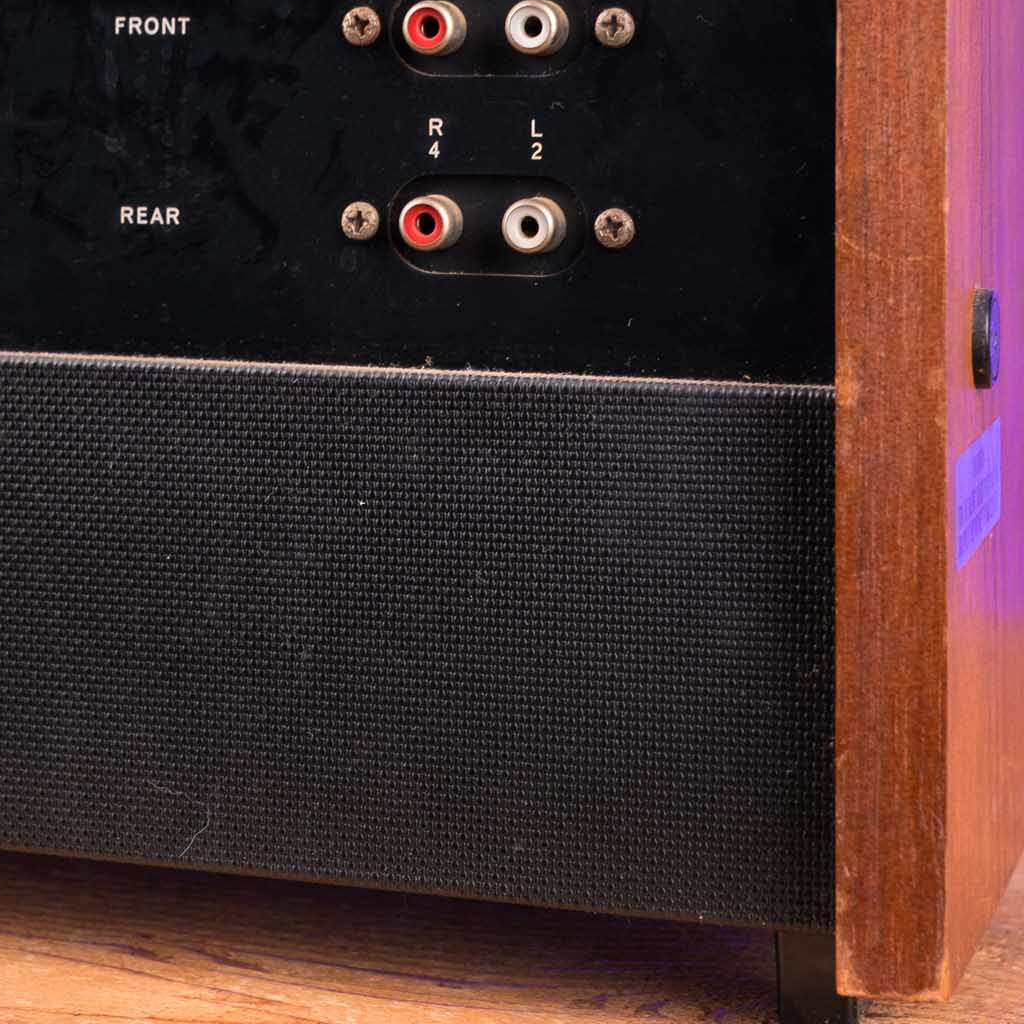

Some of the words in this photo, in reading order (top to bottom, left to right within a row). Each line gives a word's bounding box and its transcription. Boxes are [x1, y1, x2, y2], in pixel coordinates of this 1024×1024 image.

[114, 17, 190, 35] FRONT
[428, 118, 443, 137] R
[531, 119, 543, 137] L
[428, 141, 441, 159] 4
[531, 142, 543, 160] 2
[119, 206, 181, 225] REAR
